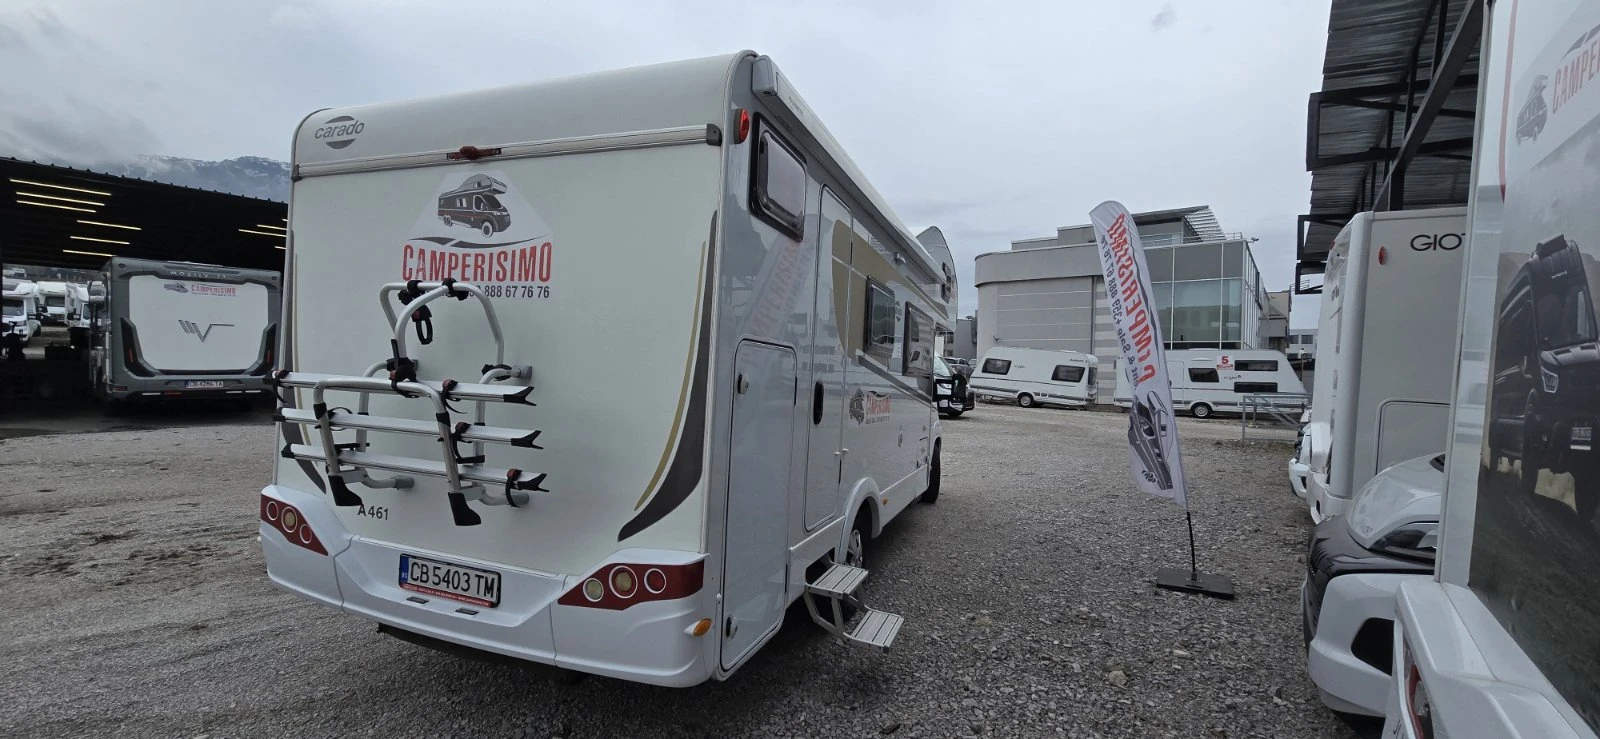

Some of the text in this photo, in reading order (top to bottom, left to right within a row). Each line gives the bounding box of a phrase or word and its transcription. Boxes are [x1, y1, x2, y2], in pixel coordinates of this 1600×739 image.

[1552, 38, 1600, 114] CAMPE
[314, 120, 365, 139] carado
[1410, 232, 1466, 251] GIO
[402, 242, 552, 282] CAMPERISIMO
[485, 285, 503, 298] 888
[505, 285, 517, 298] 67
[521, 286, 534, 299] 76
[537, 286, 550, 299] 76
[1221, 355, 1229, 364] 5
[357, 504, 389, 521] A 461
[410, 561, 430, 584] CB
[432, 566, 471, 592] 5403
[474, 573, 496, 599] TM
